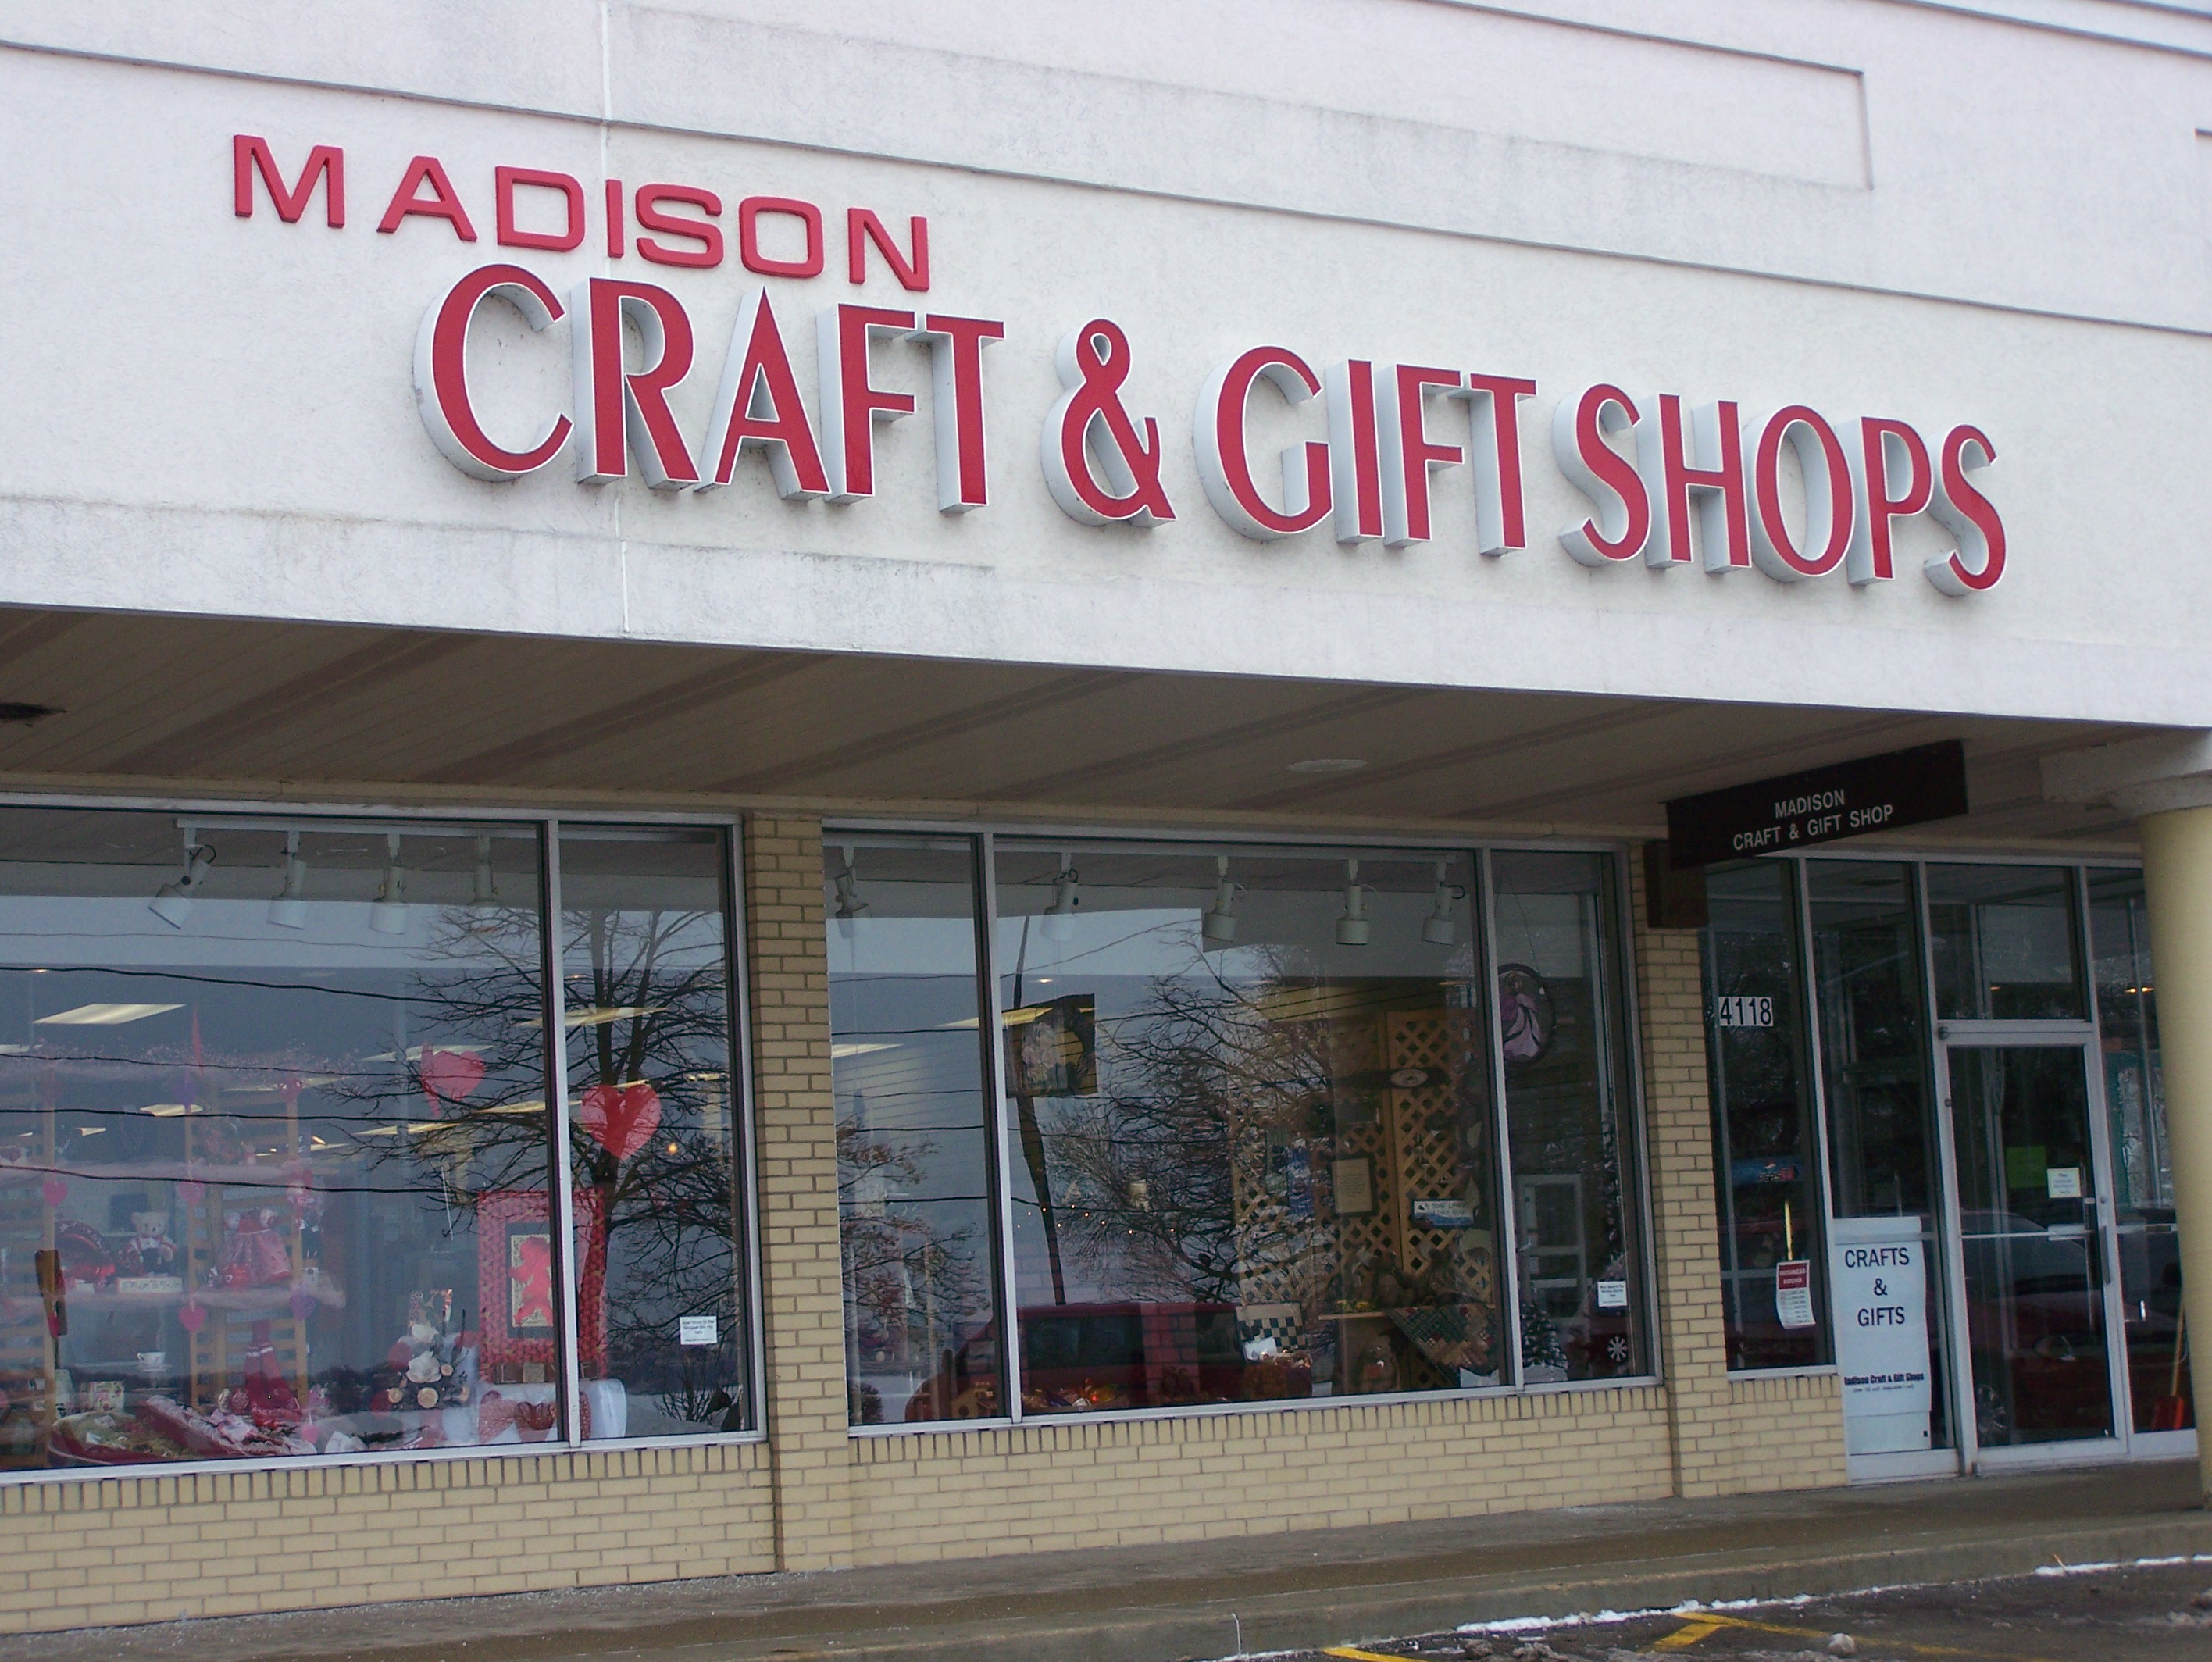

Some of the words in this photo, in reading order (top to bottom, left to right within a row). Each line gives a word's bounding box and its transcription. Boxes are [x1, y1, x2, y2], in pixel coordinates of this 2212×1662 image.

[233, 134, 929, 292] MADISON
[423, 262, 1005, 509] CRAFT
[1051, 317, 1178, 524] &
[1207, 344, 1538, 552] GIFT
[1564, 382, 2008, 594] SHOPS
[1774, 788, 1846, 819] MADISON
[1732, 825, 1782, 851] CRAFT
[1788, 823, 1800, 840] &
[1807, 814, 1843, 837] GIFT
[1849, 804, 1894, 829] SHOP
[1720, 997, 1772, 1025] 4118
[1844, 1247, 1911, 1269] CRAFTS
[1873, 1277, 1889, 1296] &
[1857, 1306, 1906, 1327] GIFTS
